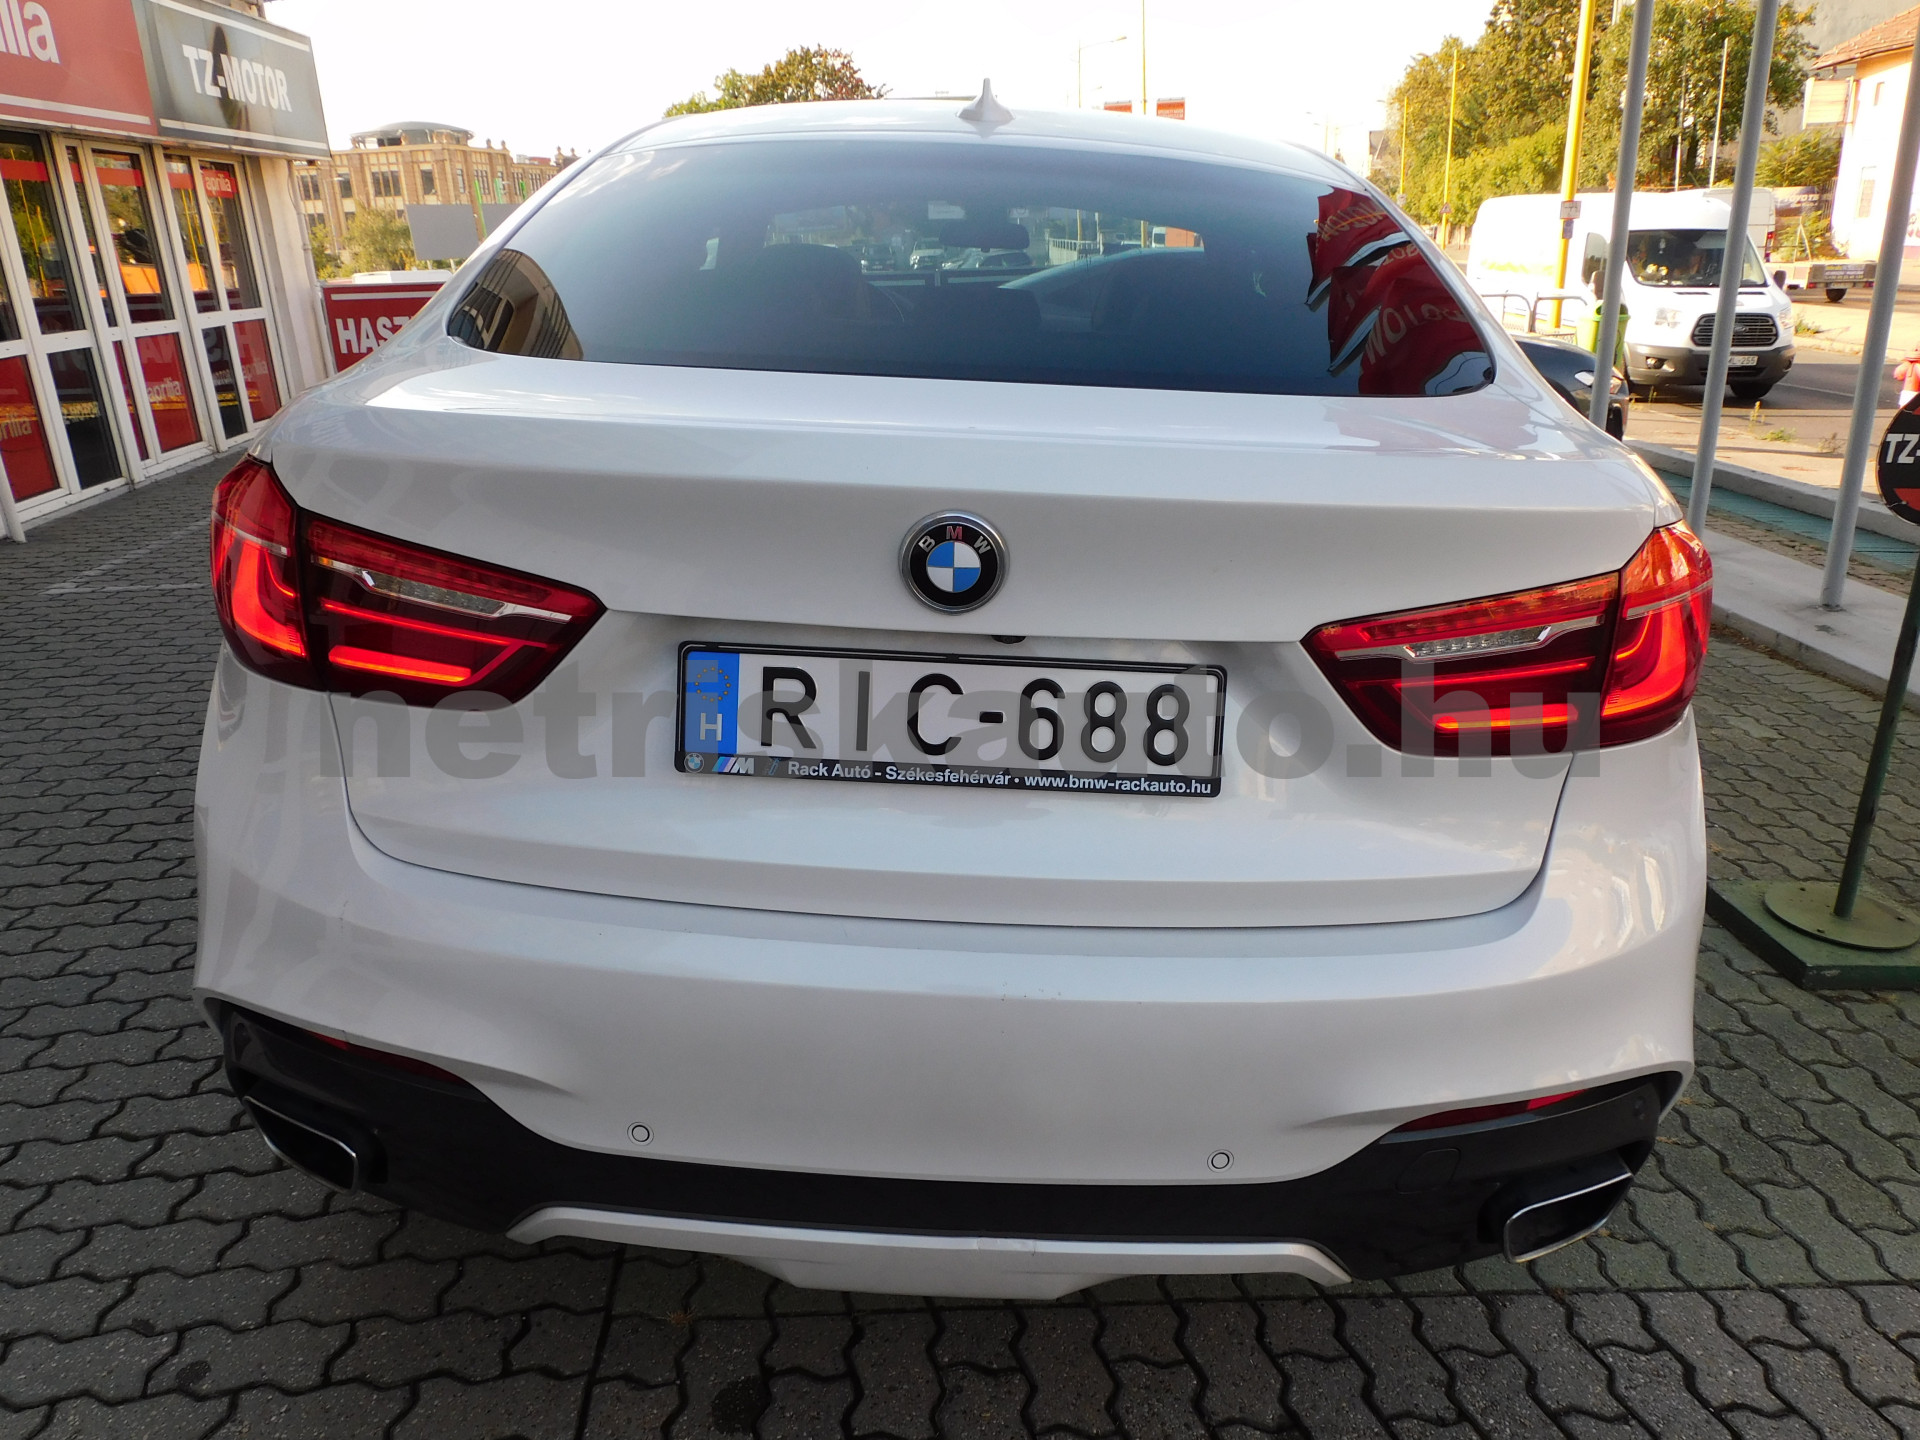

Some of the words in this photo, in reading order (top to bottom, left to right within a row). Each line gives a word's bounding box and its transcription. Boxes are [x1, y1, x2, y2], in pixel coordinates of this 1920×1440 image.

[182, 44, 292, 112] TZ-MOTOR
[147, 376, 182, 404] aprilia
[918, 525, 992, 554] BMW
[699, 711, 723, 741] H
[761, 666, 1190, 767] RIC-688
[787, 760, 829, 776] Rack
[831, 762, 871, 779] Autó
[885, 765, 1011, 786] Székesfehérvár
[1024, 774, 1212, 794] www.bmw-rackauto.hu
